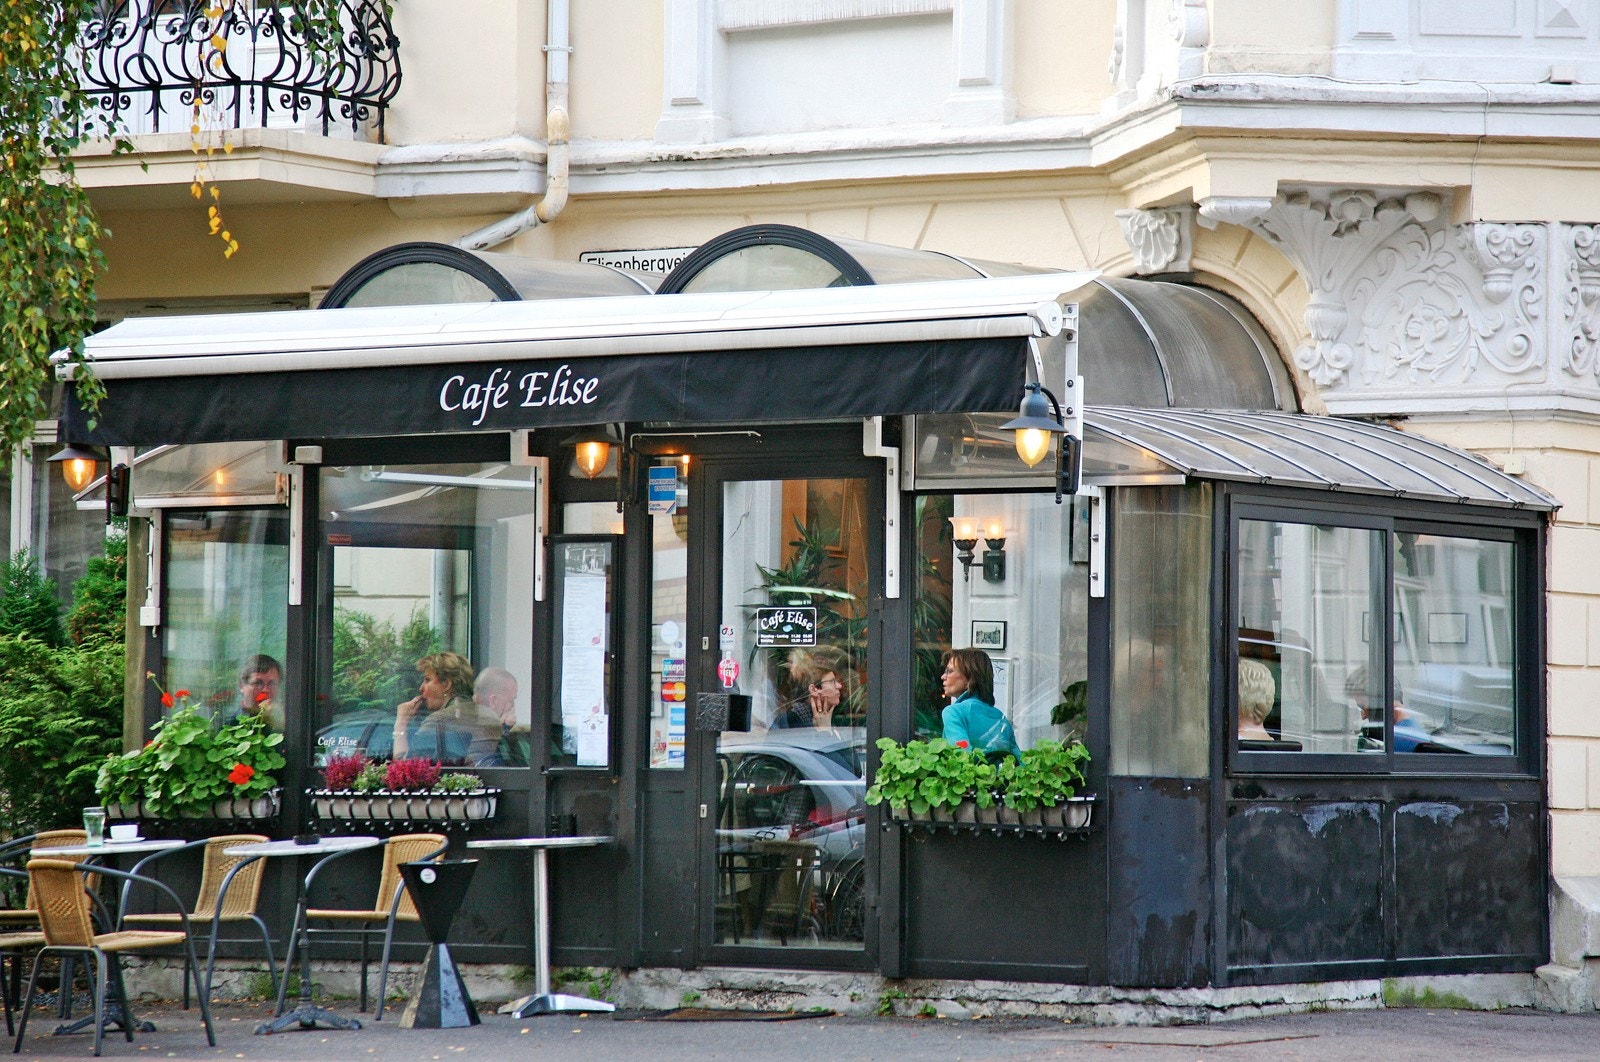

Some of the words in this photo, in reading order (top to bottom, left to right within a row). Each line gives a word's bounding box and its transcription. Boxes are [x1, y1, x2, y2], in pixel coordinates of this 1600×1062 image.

[440, 367, 511, 426] Café
[519, 364, 599, 408] Elise
[760, 610, 785, 630] Café
[786, 611, 813, 630] Elise
[317, 736, 336, 747] Café
[337, 736, 358, 746] Elise
